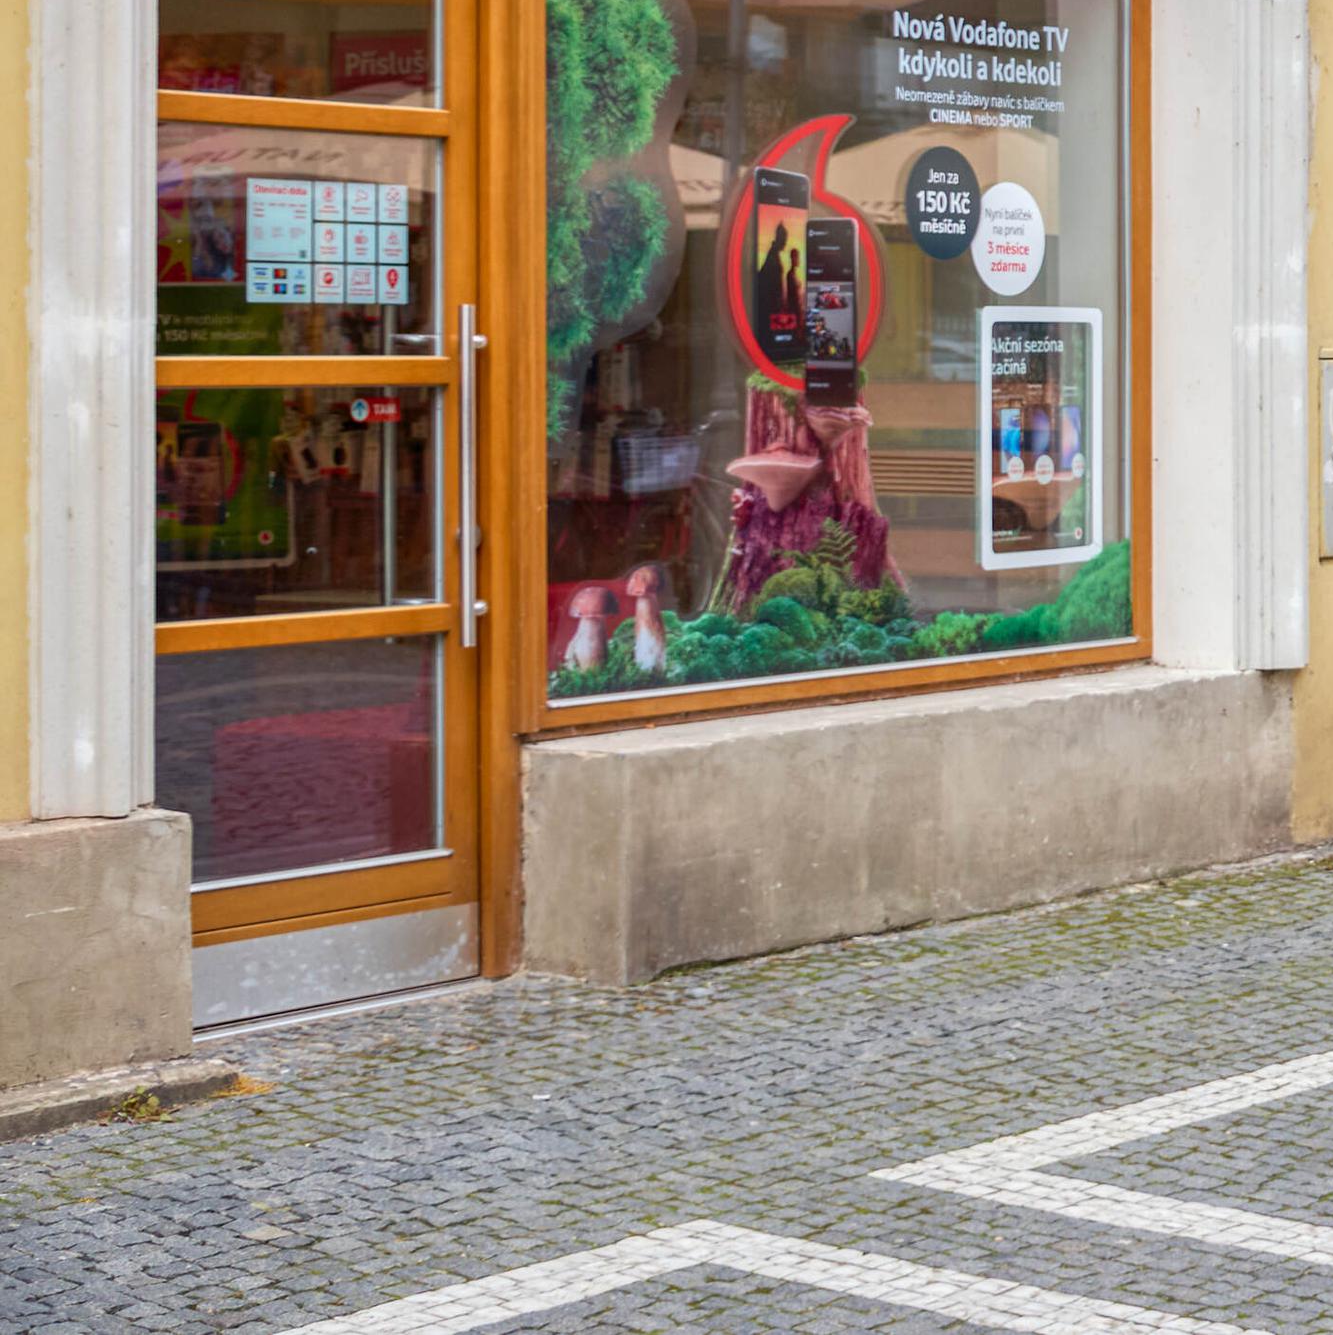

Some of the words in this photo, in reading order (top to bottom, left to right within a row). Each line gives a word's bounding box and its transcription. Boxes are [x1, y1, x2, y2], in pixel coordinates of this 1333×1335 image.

[893, 10, 945, 42] Nová
[949, 16, 1040, 50] Vodafone
[1043, 26, 1069, 53] TV
[898, 47, 973, 83] kdykoli
[976, 60, 988, 81] a
[992, 56, 1062, 87] kdekoli
[956, 90, 990, 111] zábavy
[991, 94, 1015, 110] navíc
[1017, 98, 1022, 110] s
[1023, 96, 1065, 113] balíčkem
[929, 108, 974, 125] CINEMA
[974, 112, 999, 127] nebo
[999, 113, 1035, 129] SPORT
[927, 168, 946, 184] Jen
[947, 173, 960, 185] za
[916, 190, 948, 213] 150
[950, 191, 971, 215] Kč
[920, 218, 967, 235] měsíčně
[993, 225, 1003, 235] na
[988, 241, 994, 254] 3
[996, 242, 1030, 256] měsíce
[991, 260, 1027, 273] zdarma
[1024, 336, 1064, 353] sezóna
